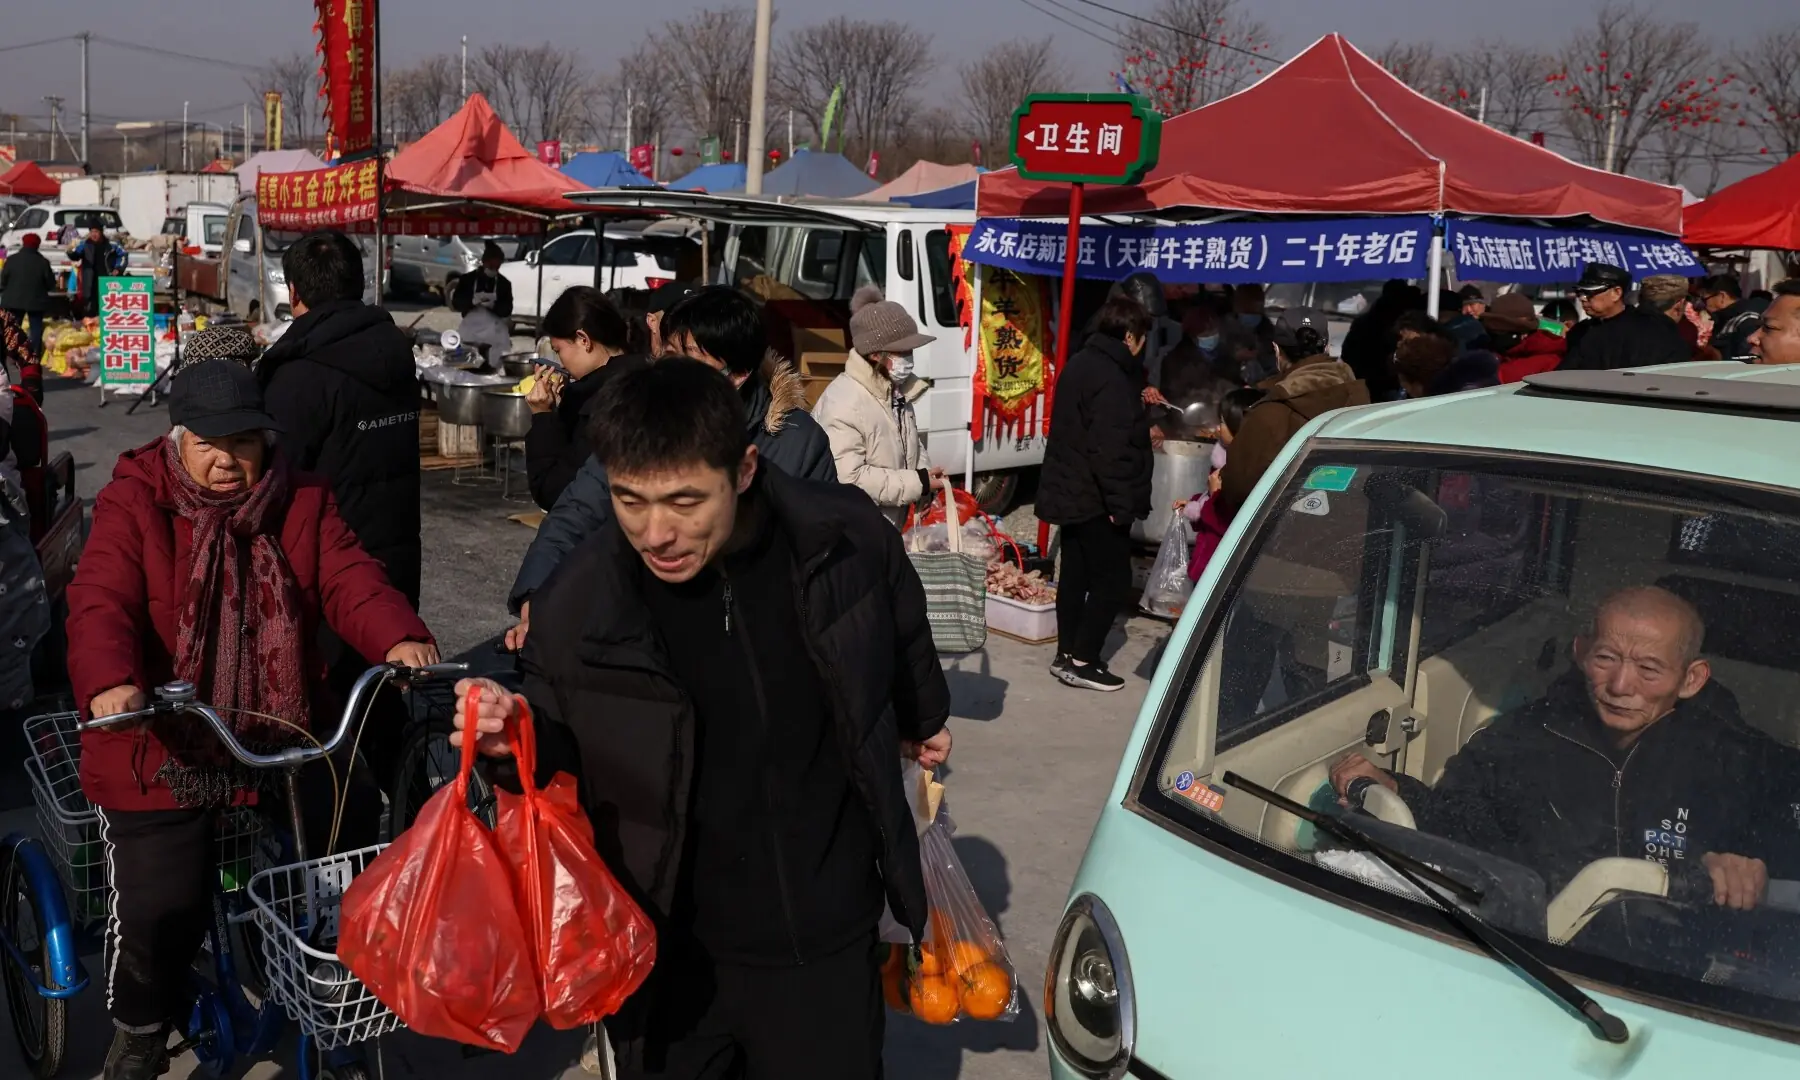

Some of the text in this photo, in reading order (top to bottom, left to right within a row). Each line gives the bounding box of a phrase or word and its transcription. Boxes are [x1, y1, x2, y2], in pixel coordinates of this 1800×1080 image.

[1035, 121, 1123, 156] 卫生间
[103, 291, 150, 371] 烟丝烟叶
